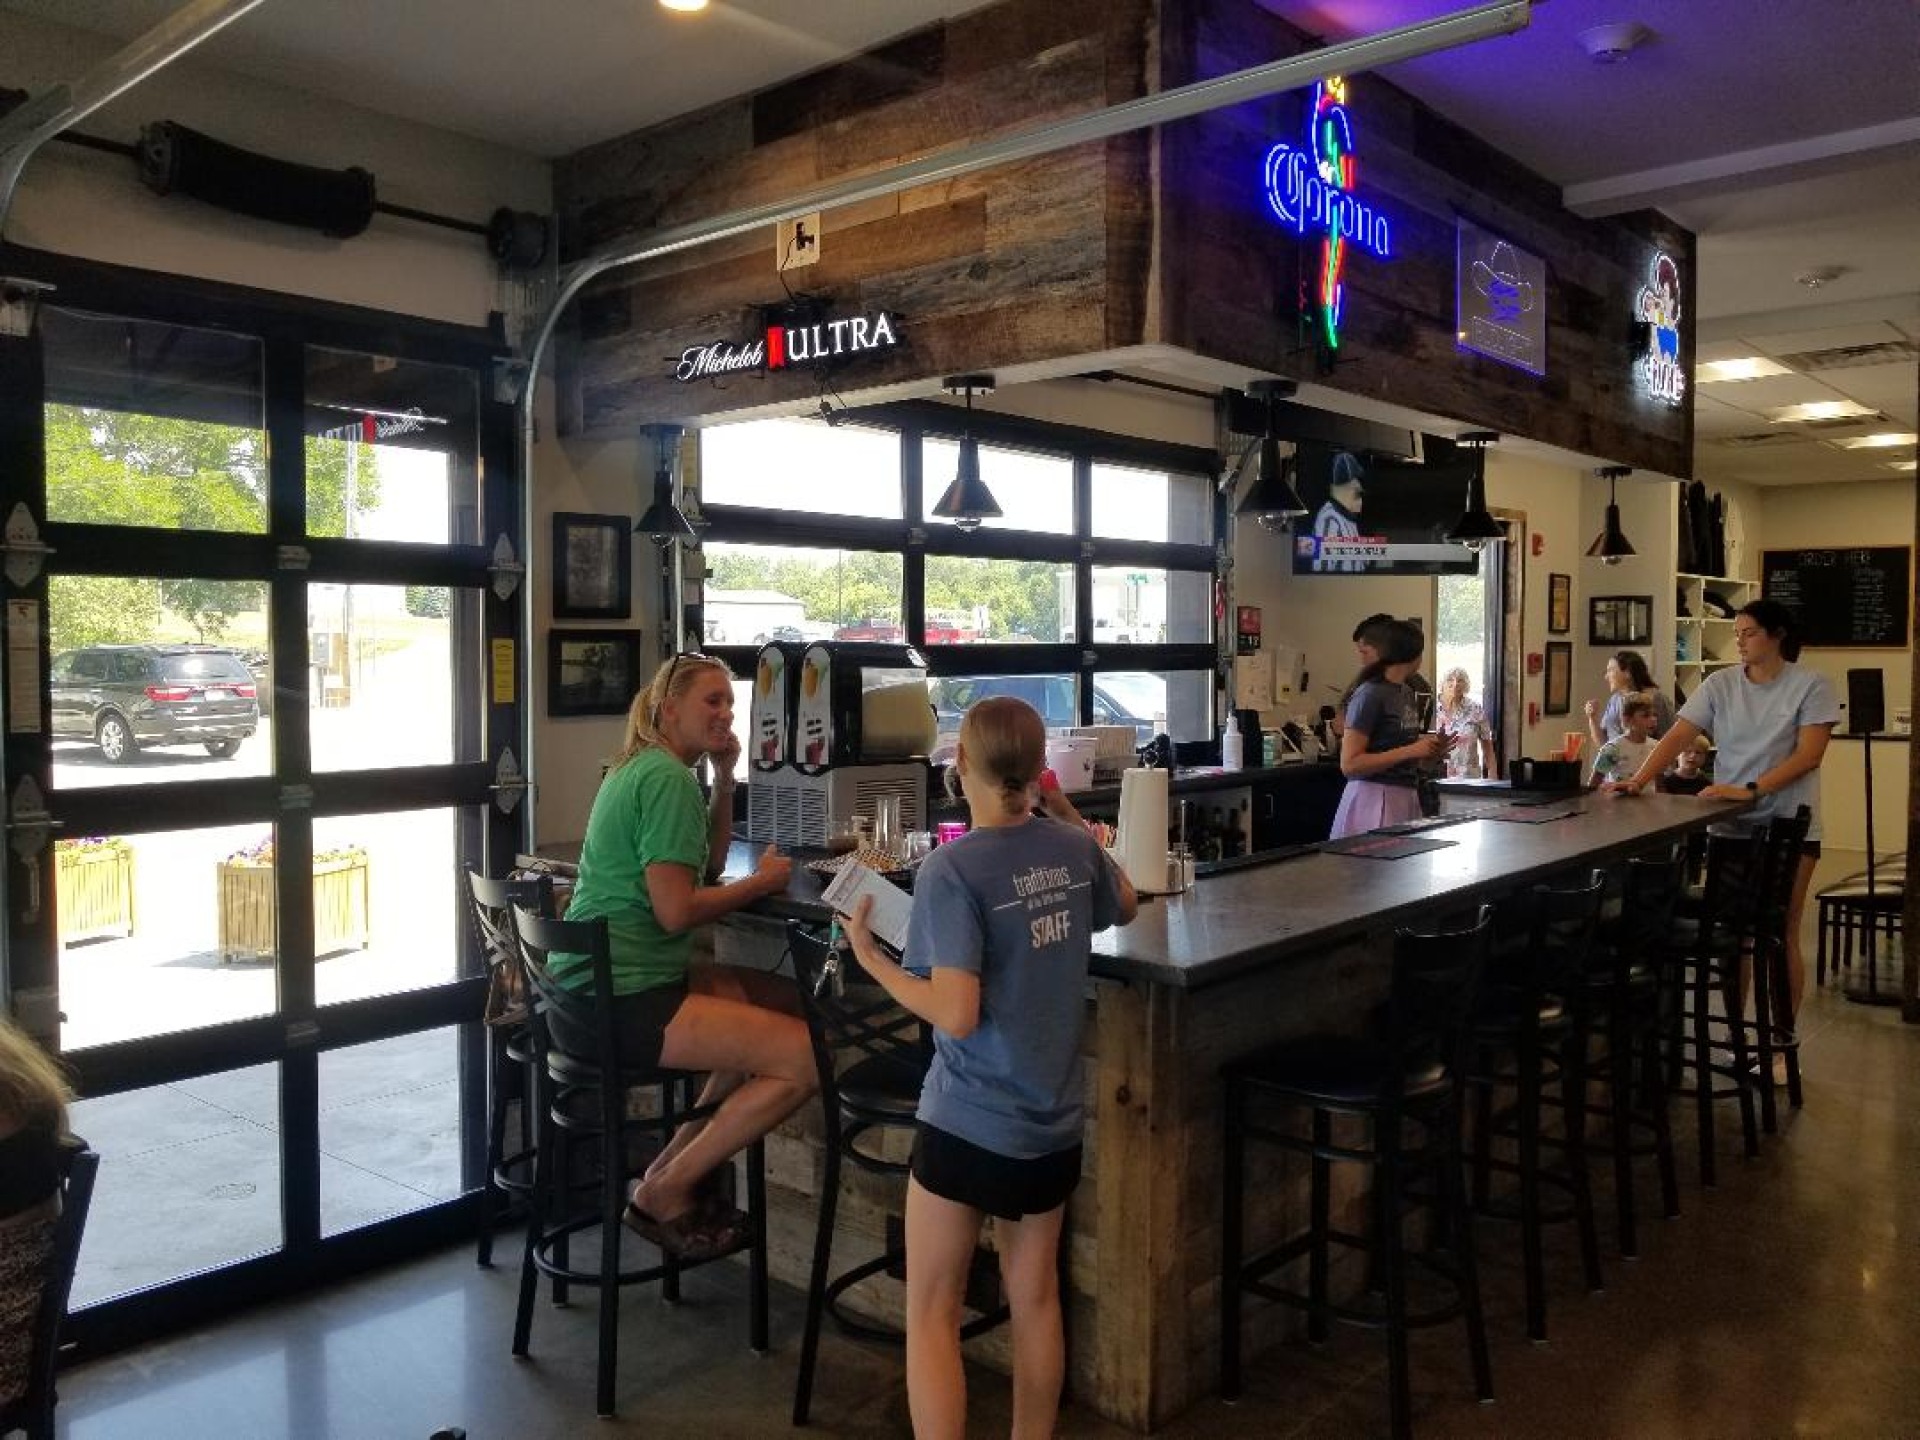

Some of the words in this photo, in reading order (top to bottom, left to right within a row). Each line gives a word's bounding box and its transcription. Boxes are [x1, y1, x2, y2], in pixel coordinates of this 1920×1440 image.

[1266, 143, 1389, 255] Corona
[676, 341, 764, 381] Michelob
[787, 312, 896, 361] ULTRA
[1013, 867, 1071, 897] traditions
[1031, 910, 1071, 949] STAFF
